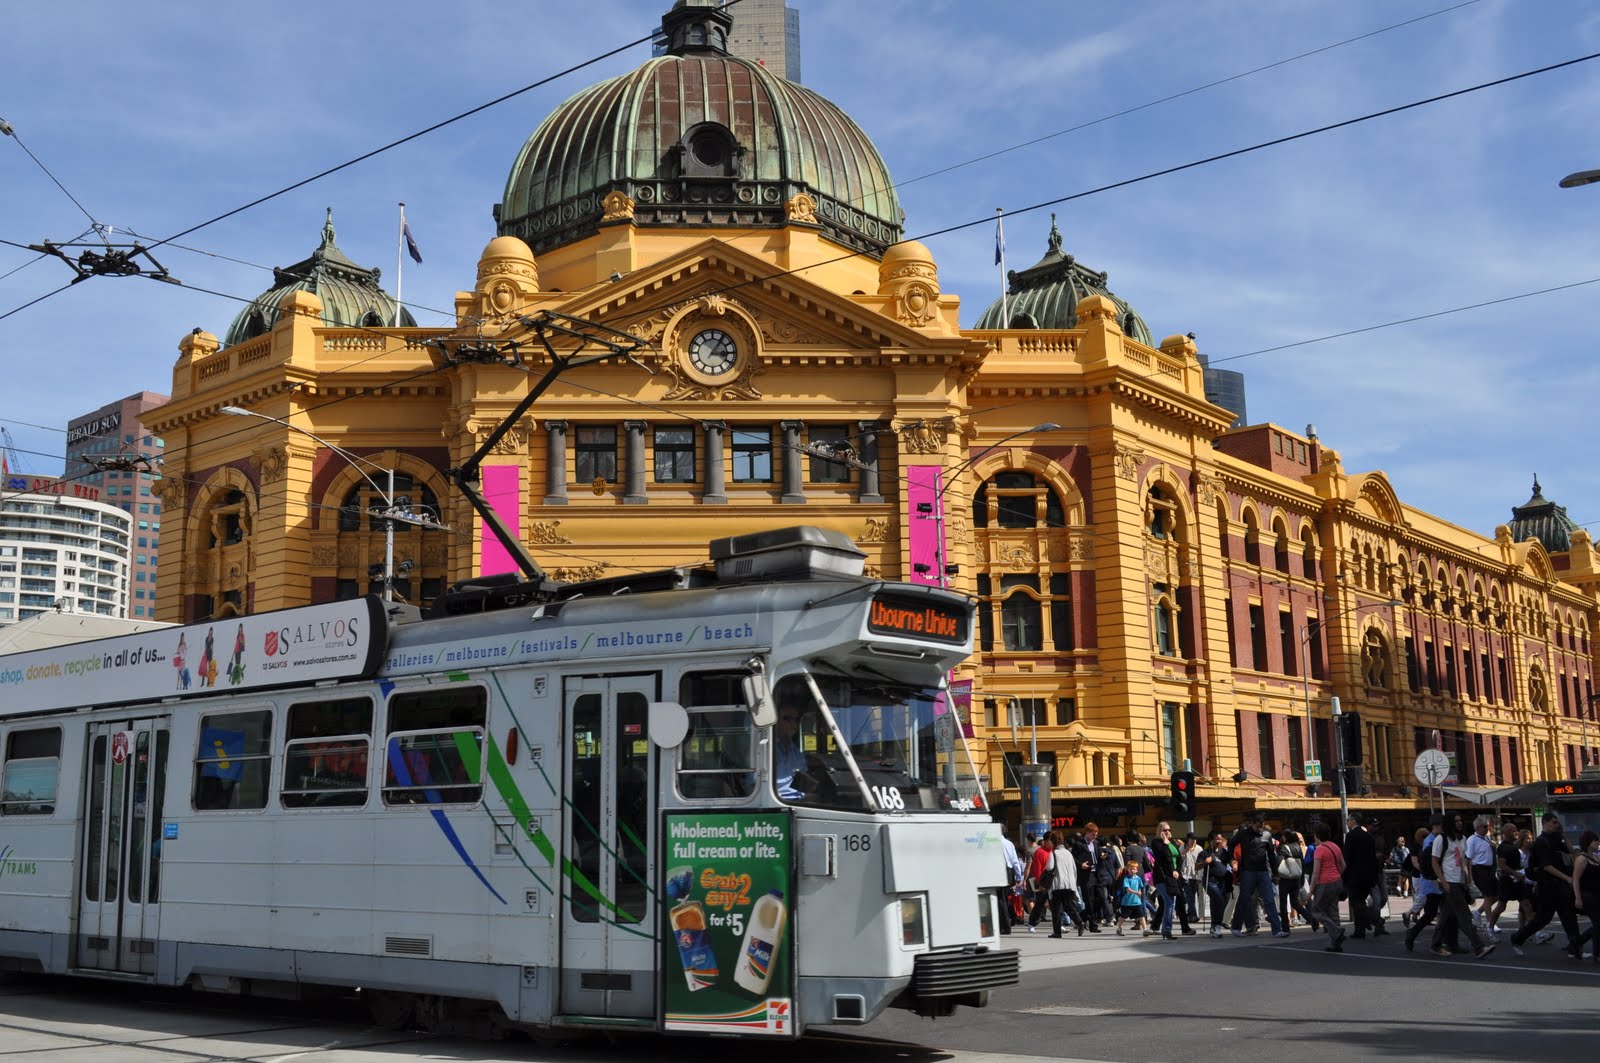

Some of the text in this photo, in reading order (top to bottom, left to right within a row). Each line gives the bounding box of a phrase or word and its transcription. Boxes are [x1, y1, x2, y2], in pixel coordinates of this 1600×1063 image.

[101, 414, 119, 430] SUN
[32, 479, 99, 501] QUAY WEST
[279, 617, 358, 655] SALVOS
[386, 623, 752, 671] galleries melbourne festivals melbourne beach
[26, 664, 62, 680] donate,
[64, 653, 101, 676] recycle
[103, 652, 112, 669] in
[115, 649, 128, 667] all
[130, 647, 142, 665] of
[268, 660, 288, 669] SALVOS
[871, 785, 905, 810] 168
[670, 821, 784, 841] Wholemeal, white,
[673, 841, 780, 858] full cream or lite.
[842, 834, 871, 852] 168
[7, 861, 37, 875] TRAMS
[700, 868, 739, 890] Grab
[705, 873, 752, 911] any 2
[709, 913, 744, 936] for $5
[754, 948, 771, 960] Milk
